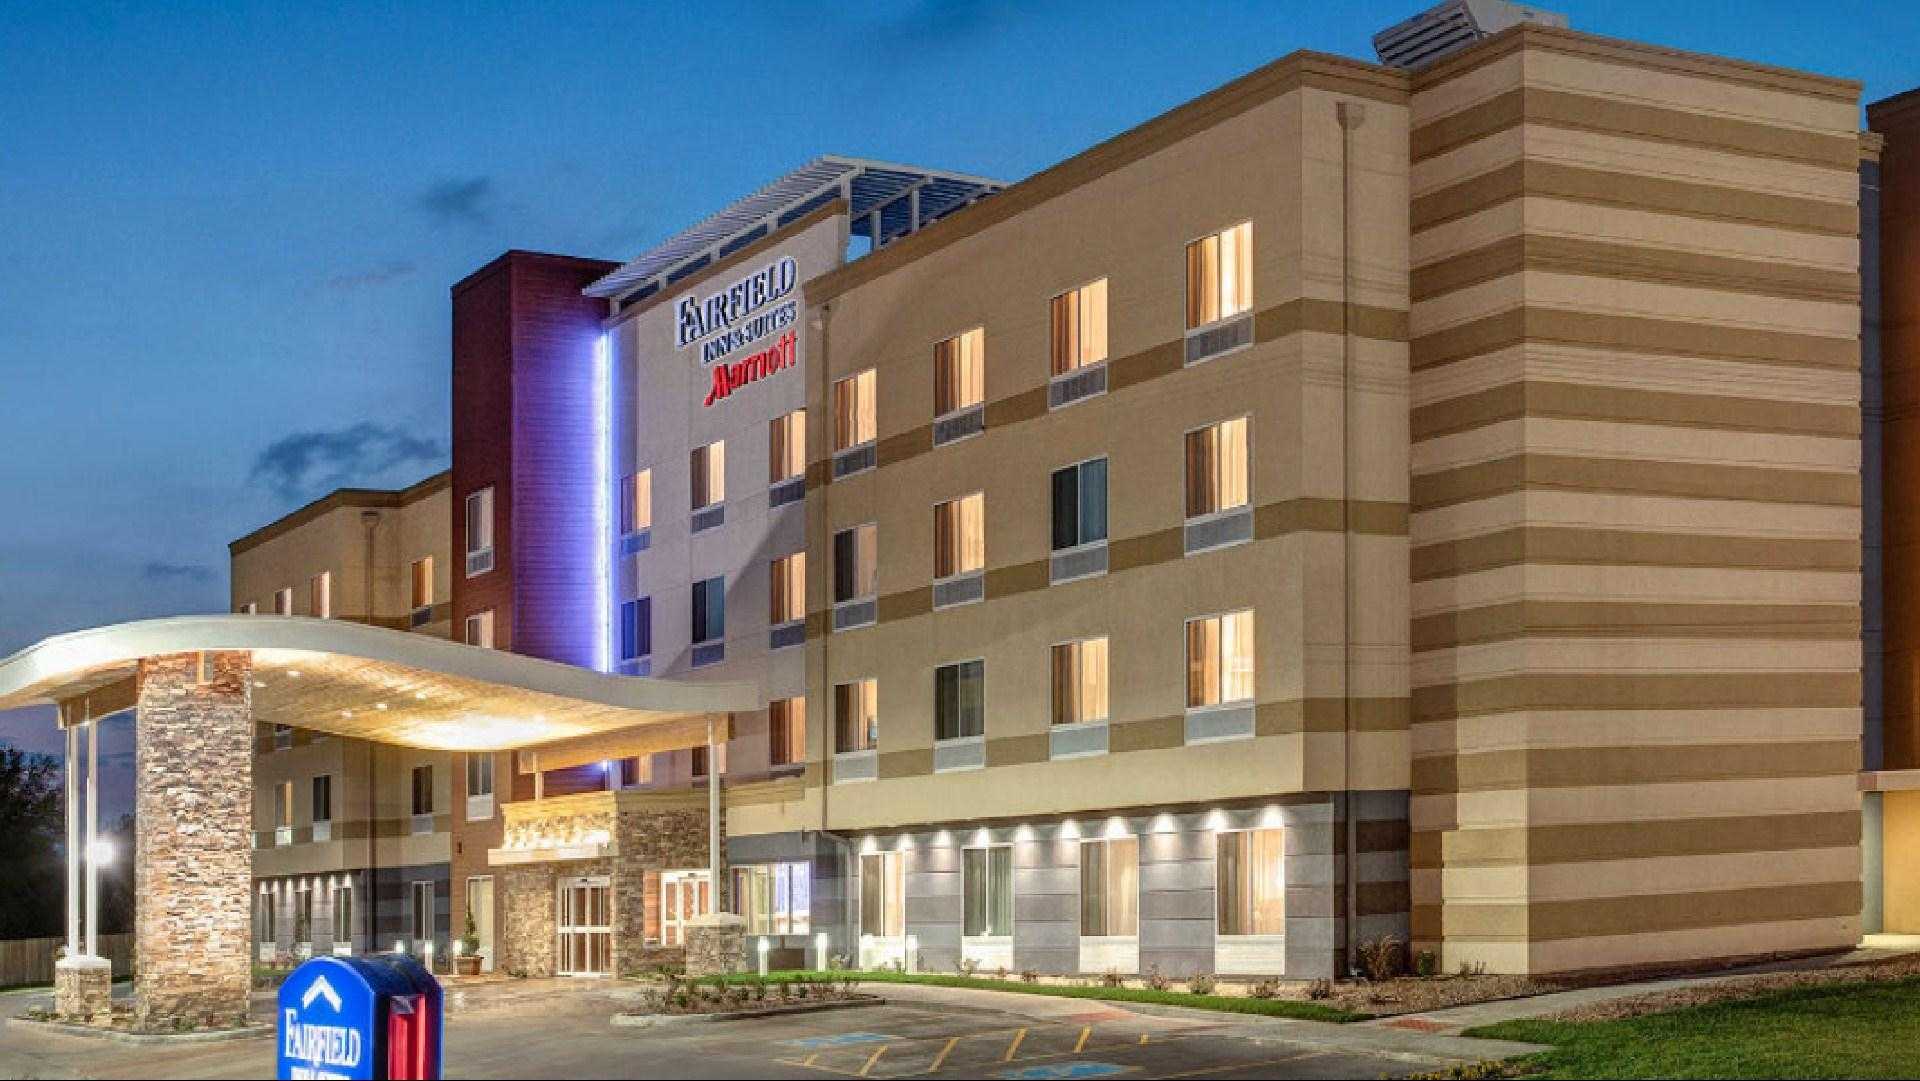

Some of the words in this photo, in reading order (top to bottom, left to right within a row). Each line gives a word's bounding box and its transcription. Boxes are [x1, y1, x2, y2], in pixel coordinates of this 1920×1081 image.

[676, 257, 797, 348] FAIRFIELD
[702, 333, 731, 365] INN
[745, 302, 797, 342] SUITES
[704, 327, 798, 407] Marriott
[285, 1008, 361, 1067] FAIRFIELD
